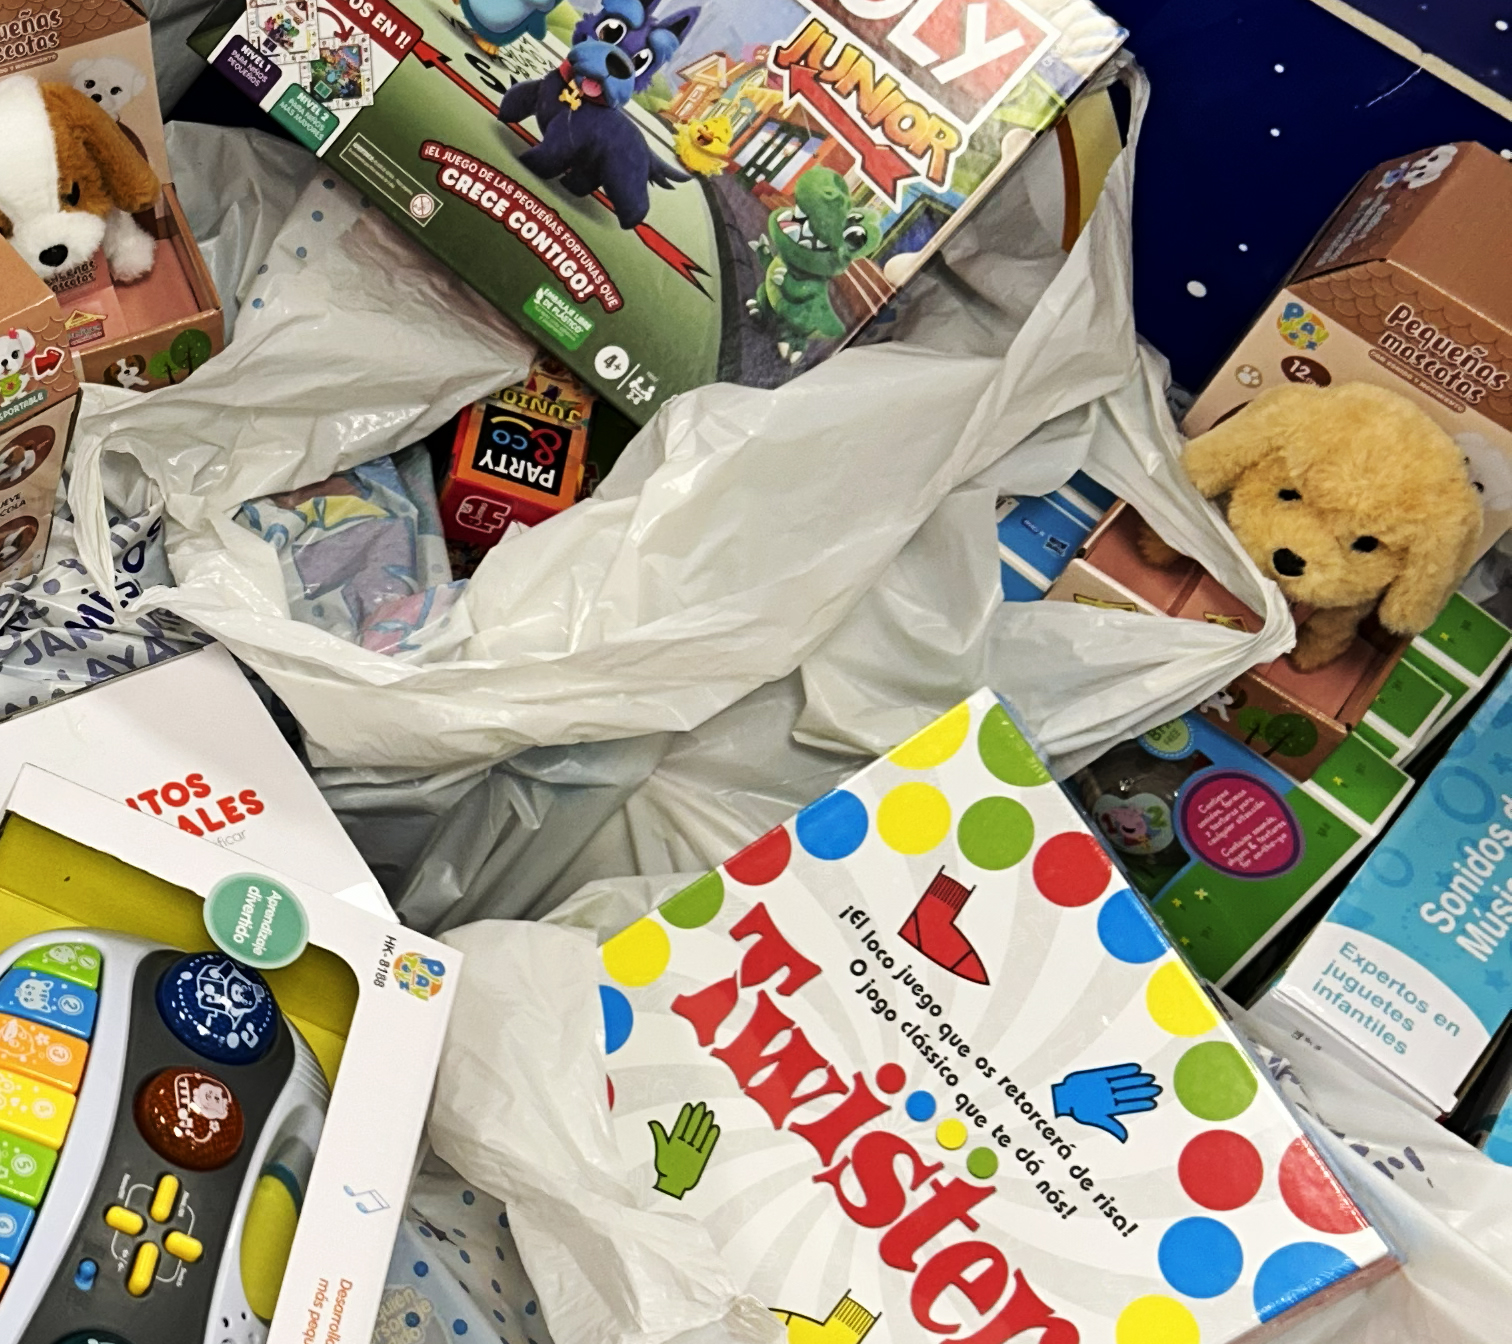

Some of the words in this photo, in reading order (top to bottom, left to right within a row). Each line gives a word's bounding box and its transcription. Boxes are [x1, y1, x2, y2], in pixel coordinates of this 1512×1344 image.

[241, 44, 266, 68] NIVEL
[371, 11, 395, 39] EN
[393, 29, 413, 50] 1!
[296, 92, 322, 116] NIVEL
[773, 16, 964, 189] JUNIOR
[441, 148, 477, 174] JUEGO
[478, 167, 495, 183] DE
[493, 173, 515, 195] LAS
[512, 187, 564, 238] PEQUEÑAS
[560, 230, 604, 285] FORTUNAS
[599, 280, 620, 309] QUE
[441, 167, 511, 218] CRECE
[508, 209, 595, 298] CONTIGO!
[1289, 359, 1311, 379] 12
[1378, 331, 1486, 405] mascotas
[1385, 302, 1510, 391] Pequeñas
[478, 449, 556, 489] PARTY
[1419, 822, 1512, 934] Sonidos
[233, 884, 260, 945] divertido
[250, 888, 283, 957] Aprendizaje
[849, 957, 868, 978] O
[1321, 959, 1415, 1033] juguetes
[1339, 940, 1429, 1015] Expertos
[1432, 1009, 1461, 1038] en
[855, 977, 898, 1022] jogo
[1311, 978, 1409, 1056] infantiles
[838, 904, 870, 931] ¡El
[861, 929, 895, 970] loco
[892, 963, 944, 1019] juego
[938, 1022, 972, 1060] que
[974, 1055, 997, 1080] os
[996, 1073, 1077, 1162] retorcerá
[1068, 1163, 1094, 1192] de
[1092, 1192, 1139, 1239] risa!
[900, 1018, 960, 1088] clássico
[954, 1092, 989, 1129] que
[990, 1122, 1013, 1149] te
[1015, 1144, 1046, 1178] dá
[1034, 1178, 1079, 1221] nós!
[313, 1277, 330, 1309] más
